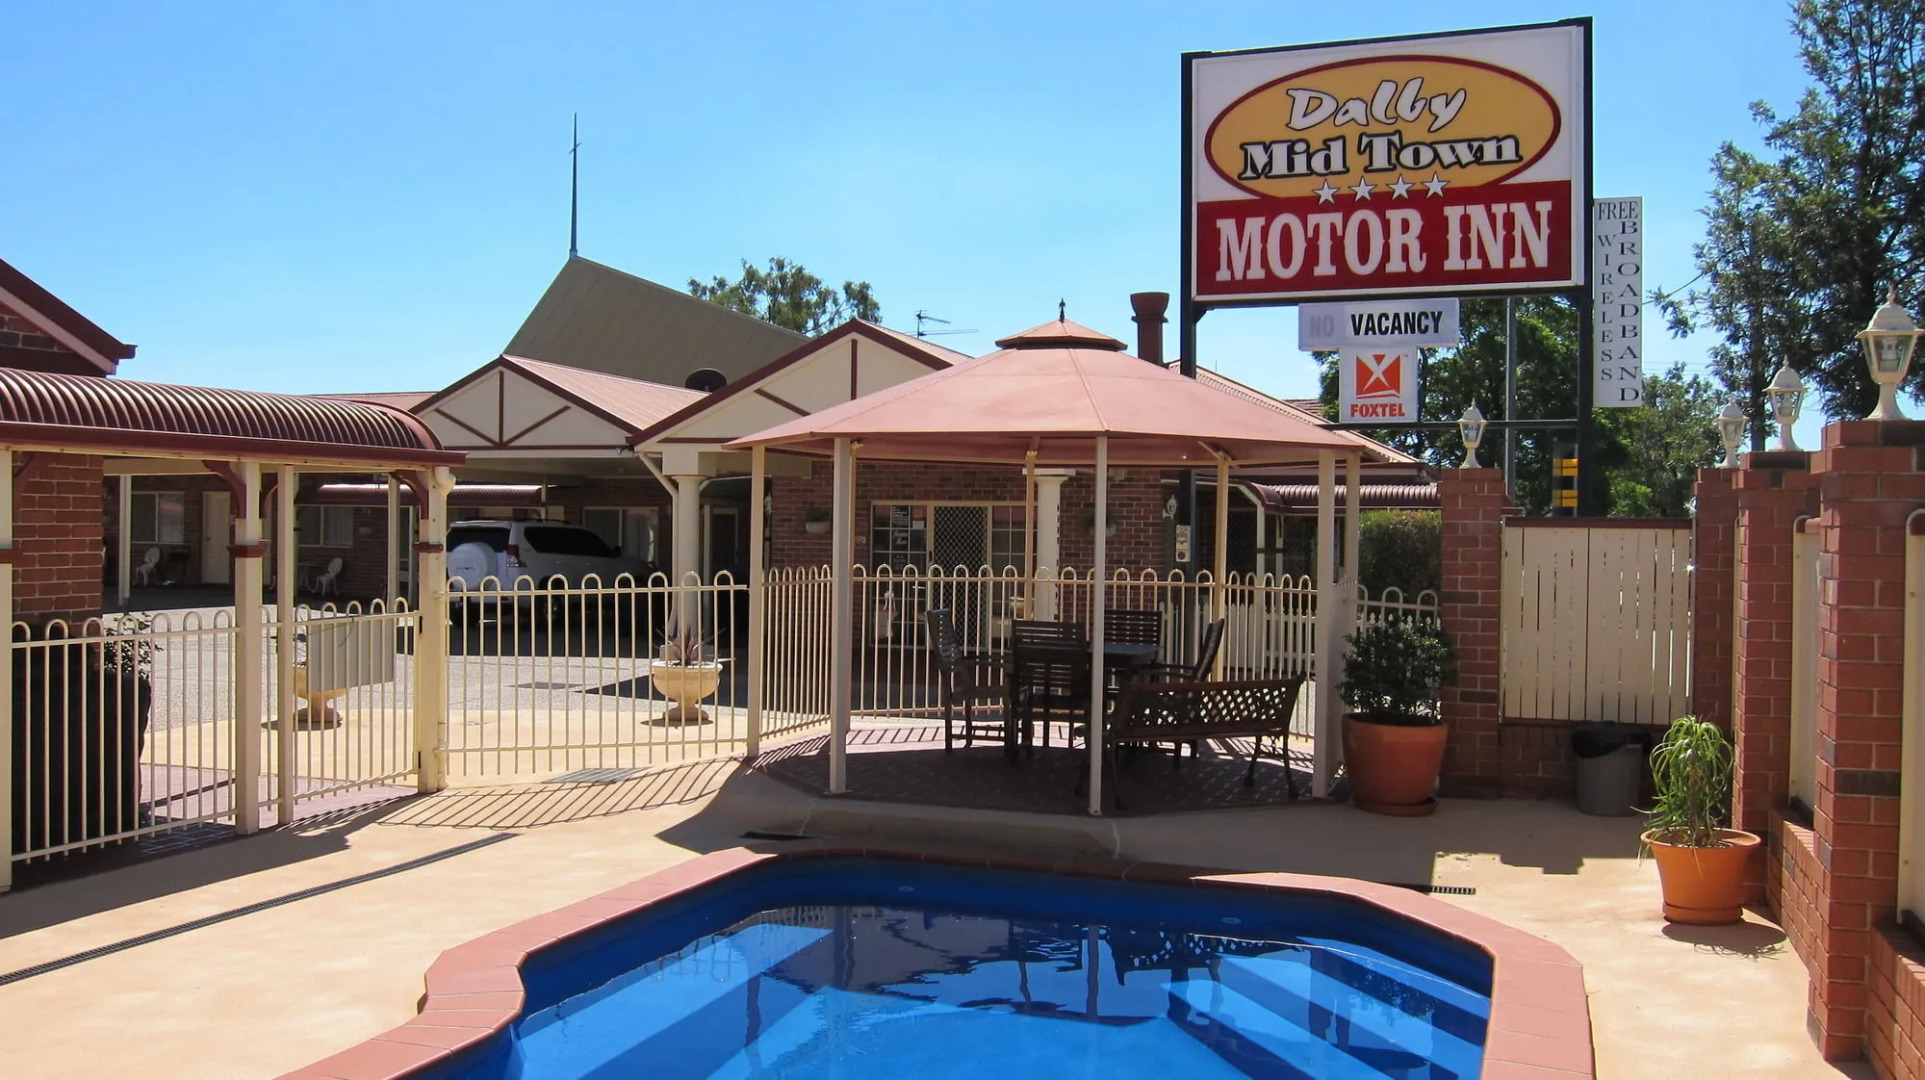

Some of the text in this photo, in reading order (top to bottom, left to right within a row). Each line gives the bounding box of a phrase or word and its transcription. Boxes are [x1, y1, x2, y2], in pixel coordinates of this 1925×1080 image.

[1286, 77, 1467, 133] Dalby
[1238, 130, 1523, 181] Mid Town
[1598, 201, 1639, 221] FREE
[1215, 201, 1553, 282] MOTOR INN
[1308, 311, 1443, 339] NO VACANCY
[1598, 234, 1616, 381] WIRELESS
[1617, 220, 1640, 401] BROADBAND
[1351, 403, 1406, 418] FOXTEL
